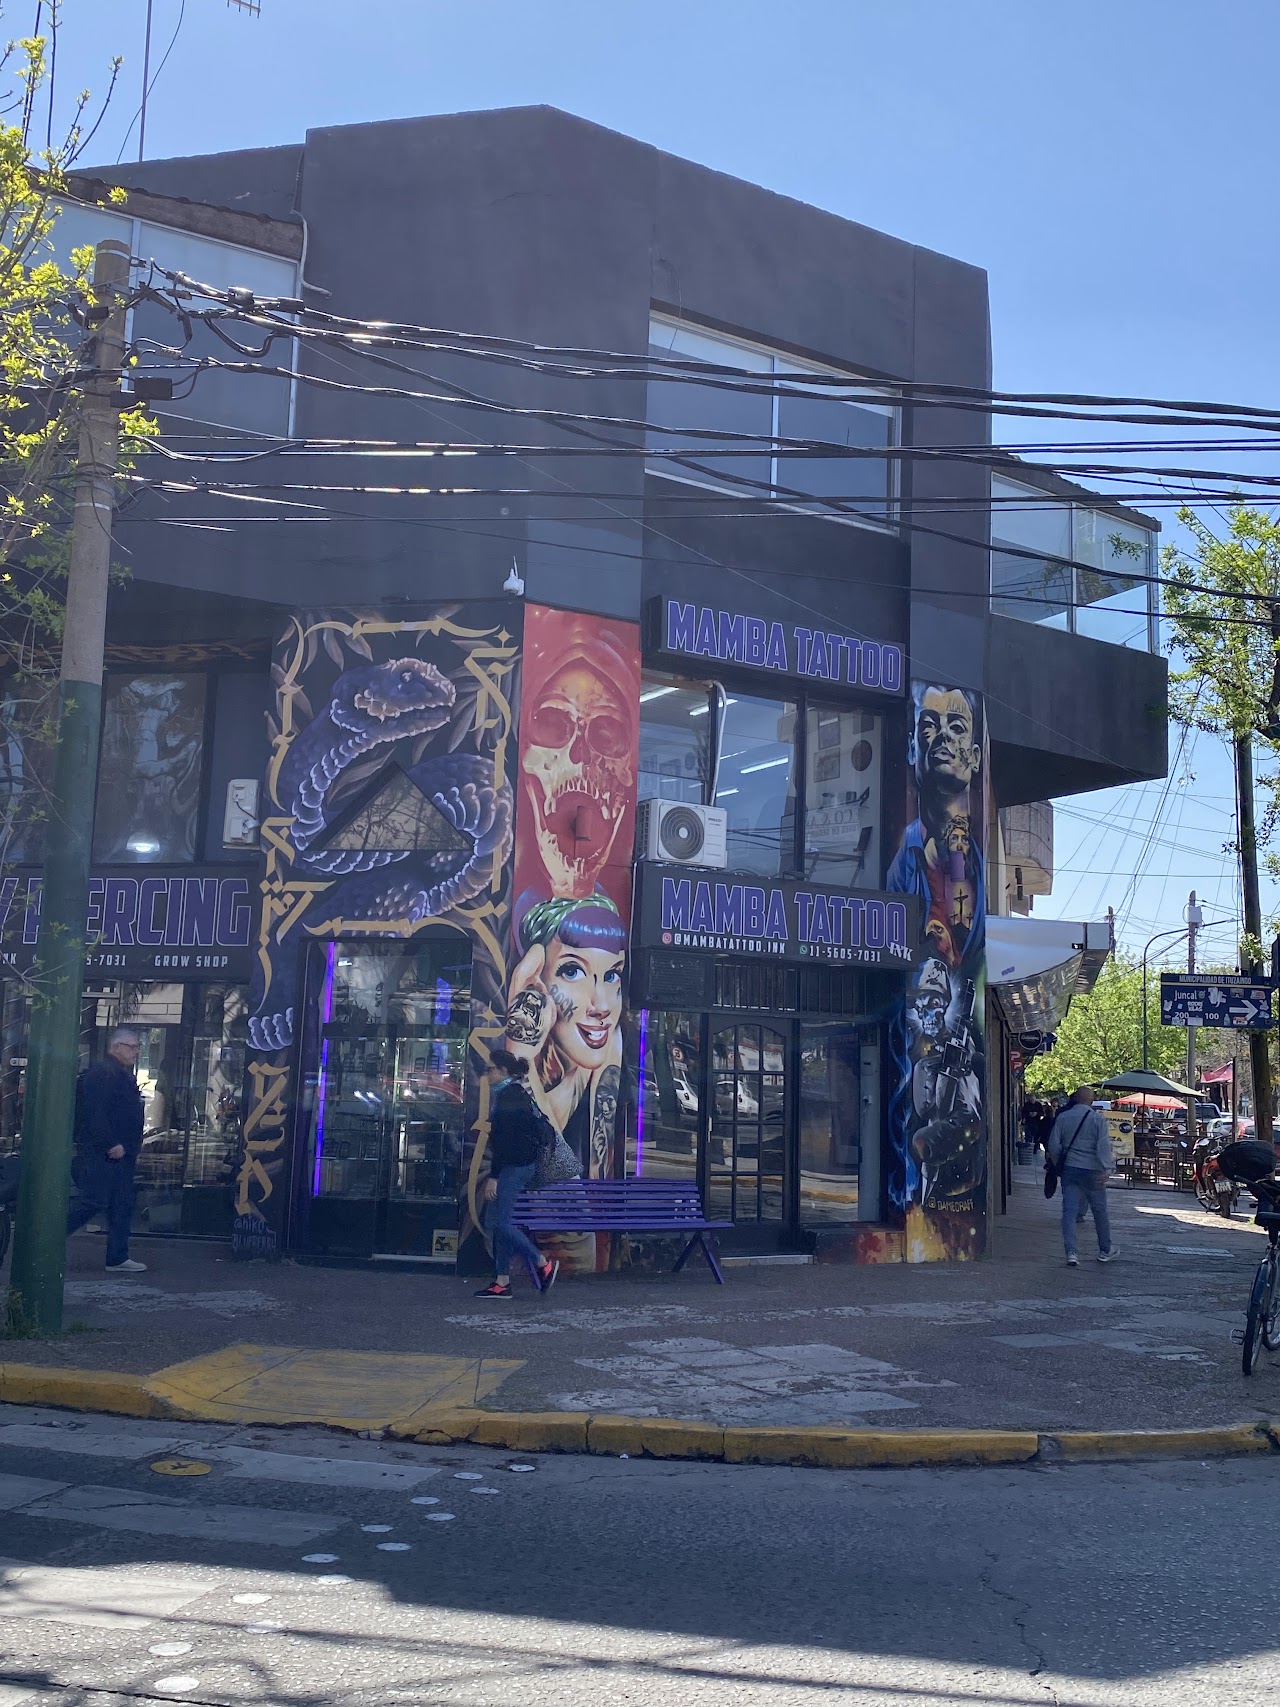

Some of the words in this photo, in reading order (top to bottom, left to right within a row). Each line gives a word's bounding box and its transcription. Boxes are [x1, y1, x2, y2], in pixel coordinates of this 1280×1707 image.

[667, 600, 788, 671] MAMBA
[793, 626, 901, 691] TATTOO
[661, 877, 788, 940] MAMBA
[794, 891, 907, 949] TATTOO
[809, 945, 881, 963] 11-5605-7031
[155, 955, 189, 968] GROW
[196, 955, 229, 968] SHOP
[1218, 976, 1225, 984] DE
[1174, 989, 1198, 1001] Juncal
[1204, 1012, 1220, 1020] 100
